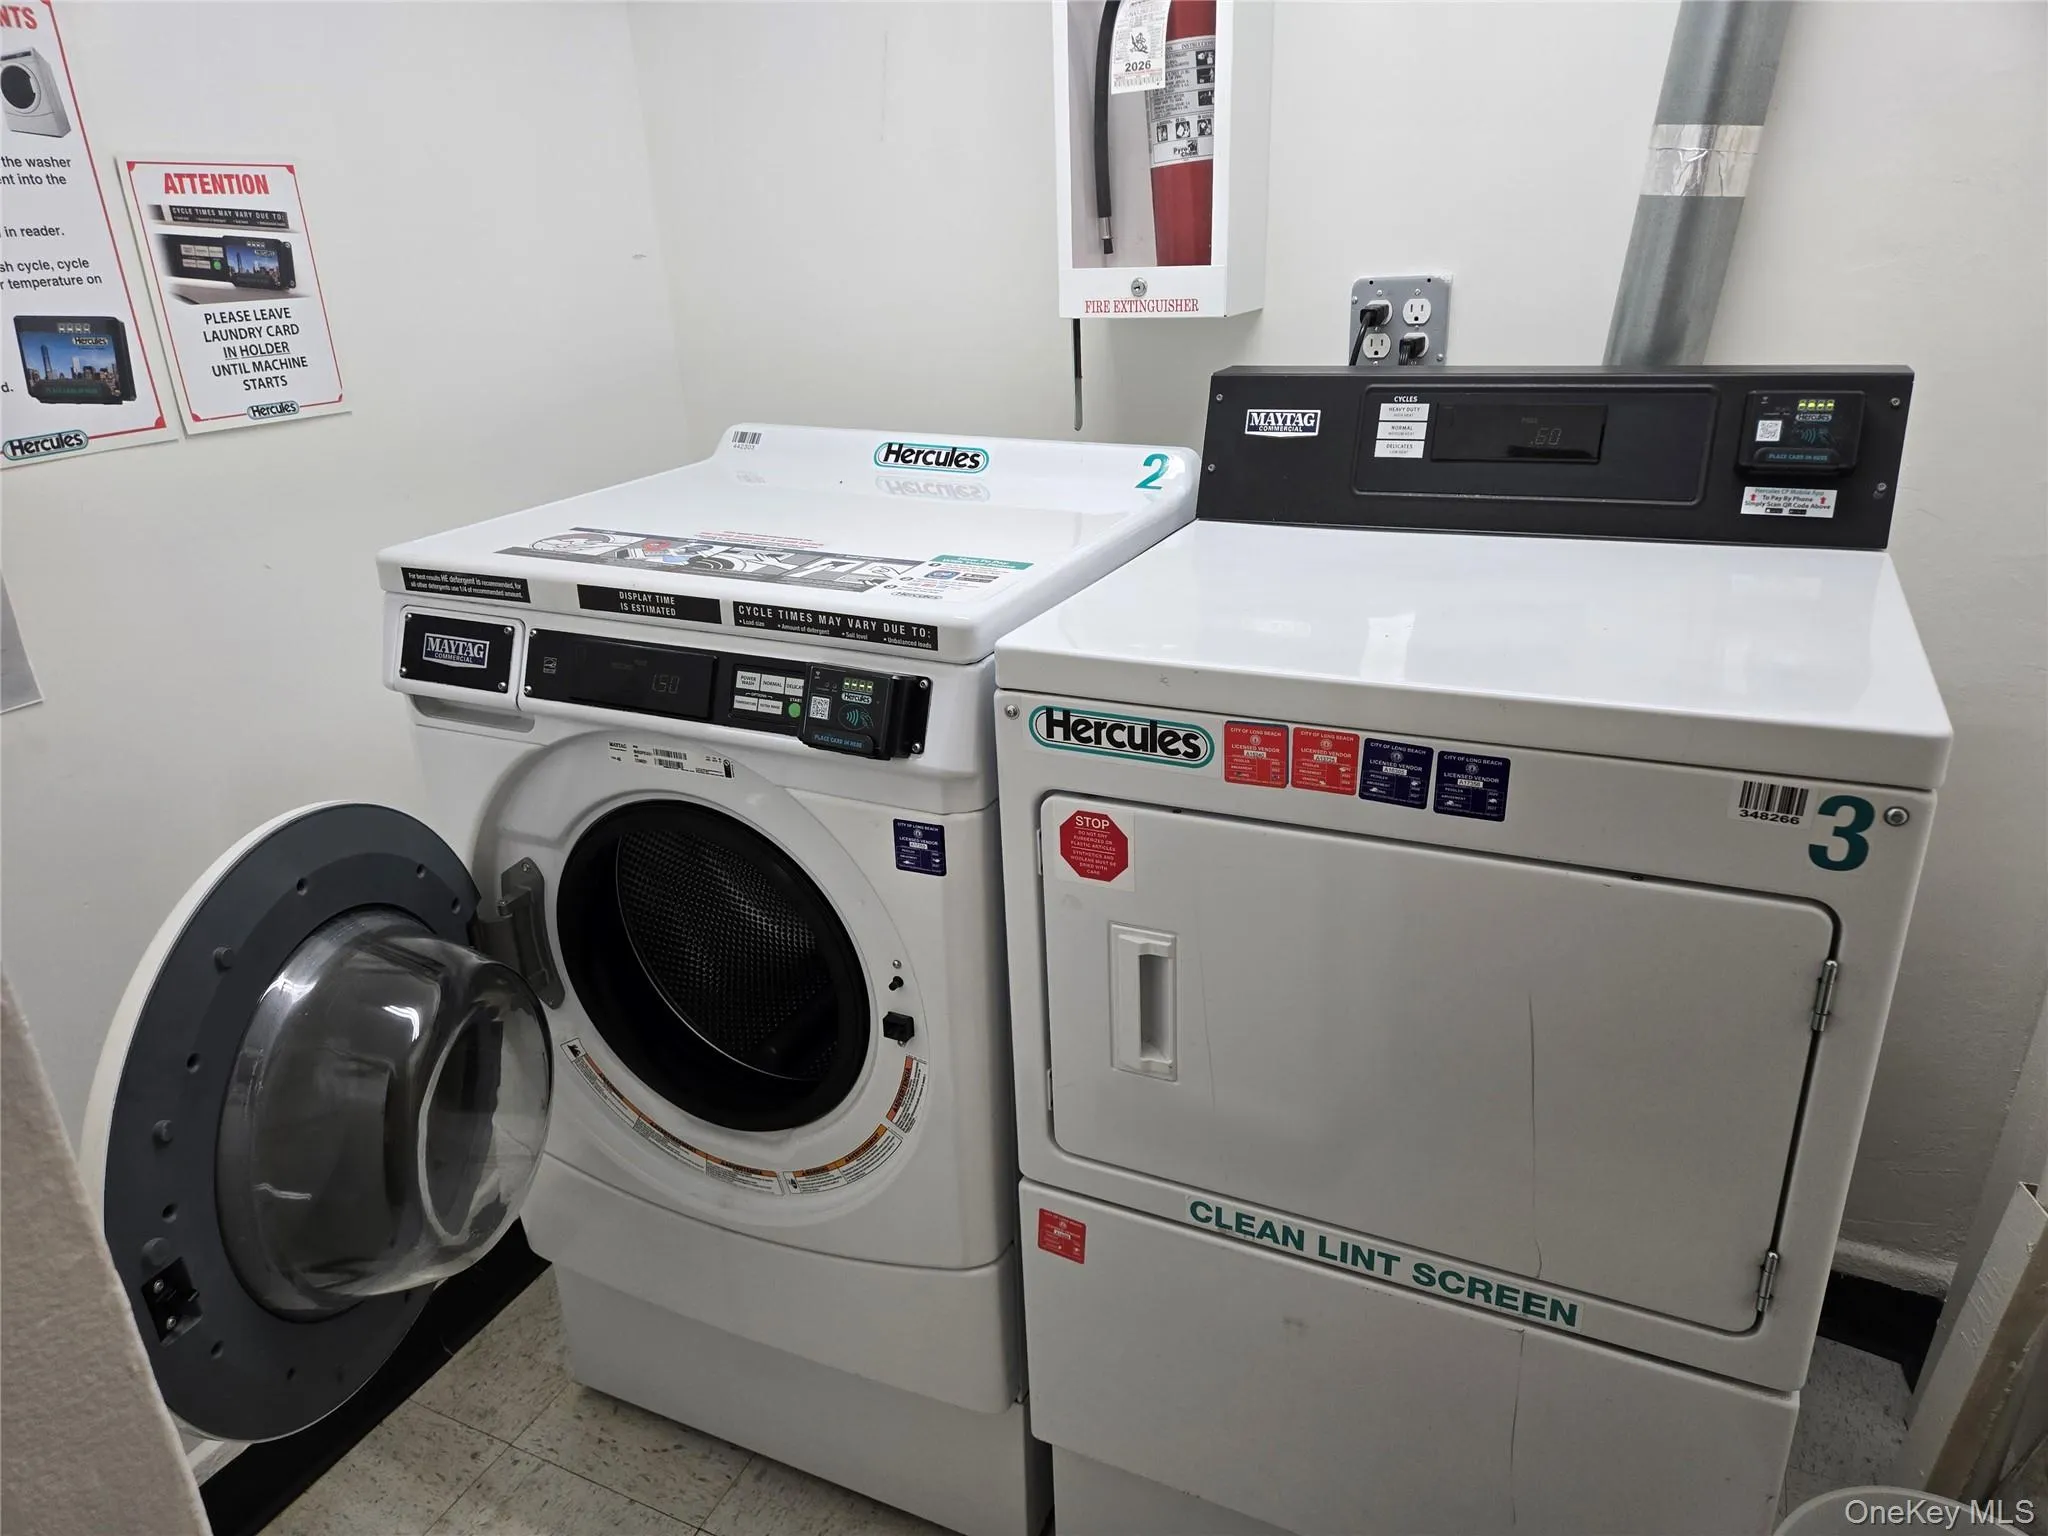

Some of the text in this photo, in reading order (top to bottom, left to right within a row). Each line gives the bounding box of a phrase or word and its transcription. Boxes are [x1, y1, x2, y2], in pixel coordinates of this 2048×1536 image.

[1125, 60, 1151, 72] 2026
[0, 156, 71, 168] the washer
[17, 173, 67, 185] into the
[164, 173, 270, 195] ATTENTION
[172, 207, 193, 215] CYCLE
[195, 208, 216, 217] TIMES
[217, 209, 232, 217] MAY
[235, 211, 252, 219] VARY
[4, 226, 65, 237] in reader.
[17, 259, 54, 273] cycle,
[57, 258, 90, 272] cycle
[8, 274, 103, 291] temperature on
[1085, 299, 1199, 313] FIRE EXTINGUISHER
[204, 307, 292, 325] PLEASE LEAVE
[203, 323, 300, 343] LAUNDRY CARD
[223, 341, 290, 358] IN HOLDER
[211, 356, 308, 377] UNTIL MACHINE
[242, 375, 288, 391] STARTS
[250, 402, 297, 417] Hercules
[1250, 412, 1316, 427] MAYTAG
[9, 432, 83, 456] Hercules
[883, 442, 981, 469] Hercules
[1135, 453, 1172, 490] 2
[449, 576, 475, 586] detergent
[619, 591, 675, 605] DISPLAY TIME
[620, 602, 676, 616] IS ESTIMATED
[738, 605, 931, 639] CYCLE TIMES MAY VARY DUE TO:
[743, 618, 755, 626] Load
[781, 623, 800, 632] Amount
[806, 625, 830, 636] detergent
[887, 637, 917, 647] Unbalanced
[918, 640, 932, 649] loads
[427, 637, 484, 658] MAYTAG
[435, 652, 473, 663] COMMERCIAL
[1046, 706, 1201, 759] Hercules
[814, 734, 830, 742] PLACE
[831, 736, 843, 744] CARD
[849, 740, 862, 748] HERE
[1370, 759, 1422, 772] LICENSED VENDOR
[1444, 772, 1473, 780] LICENSED
[1075, 815, 1110, 830] STOP
[1739, 808, 1800, 825] 348266
[1073, 835, 1105, 844] RUBBERIZED
[1808, 794, 1875, 872] 3
[1071, 840, 1116, 852] PLASTIC ARTICLES
[1073, 850, 1103, 858] SYNTHETICS
[1189, 1200, 1578, 1328] CLEAN LINT SCREEN
